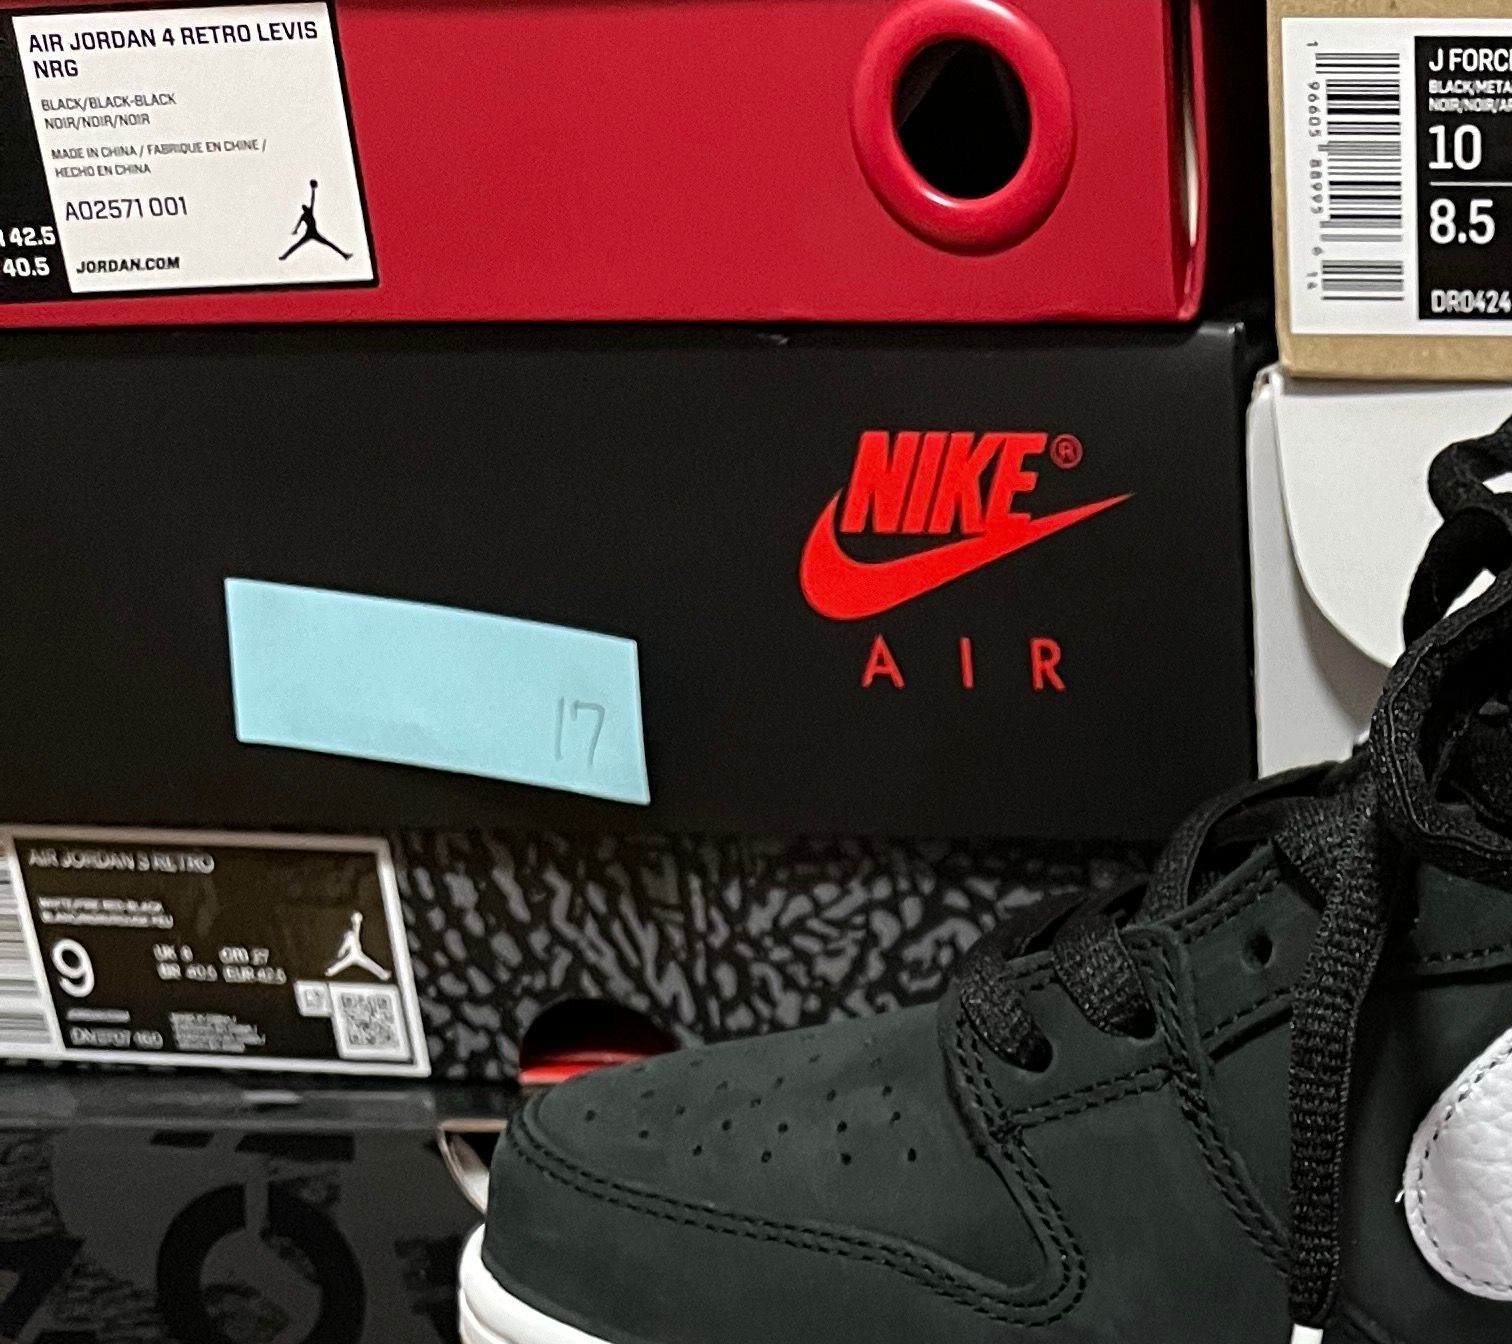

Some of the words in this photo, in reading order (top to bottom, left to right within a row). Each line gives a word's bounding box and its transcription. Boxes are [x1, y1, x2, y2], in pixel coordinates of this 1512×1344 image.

[29, 33, 63, 53] AIR
[70, 27, 156, 51] JORDAN
[163, 28, 174, 46] 4
[181, 24, 251, 45] RETRO
[256, 21, 318, 41] LEVIS
[33, 60, 79, 78] NRG
[1429, 48, 1444, 72] J
[41, 93, 176, 111] BLACK/BLACK-BLACK
[45, 113, 150, 130] NOIR/NOIR/NOIR
[51, 148, 84, 160] MADE
[87, 147, 98, 158] IN
[101, 146, 137, 158] CHINA
[206, 141, 221, 152] EN
[224, 139, 259, 151] CHINE
[1428, 124, 1482, 170] 10
[55, 166, 95, 178] HECHO
[97, 165, 112, 176] EN
[115, 164, 151, 175] CHINA
[149, 196, 187, 216] 001
[1429, 198, 1496, 245] 8.5
[9, 226, 56, 247] 42.5
[2, 256, 50, 277] 40.5
[76, 257, 180, 274] JORDAN.COM
[840, 431, 1047, 534] NIKE
[861, 634, 1066, 690] AIR
[553, 696, 606, 770] 17
[29, 849, 59, 867] AIR
[60, 851, 134, 872] JORDAN
[51, 938, 95, 998] 9
